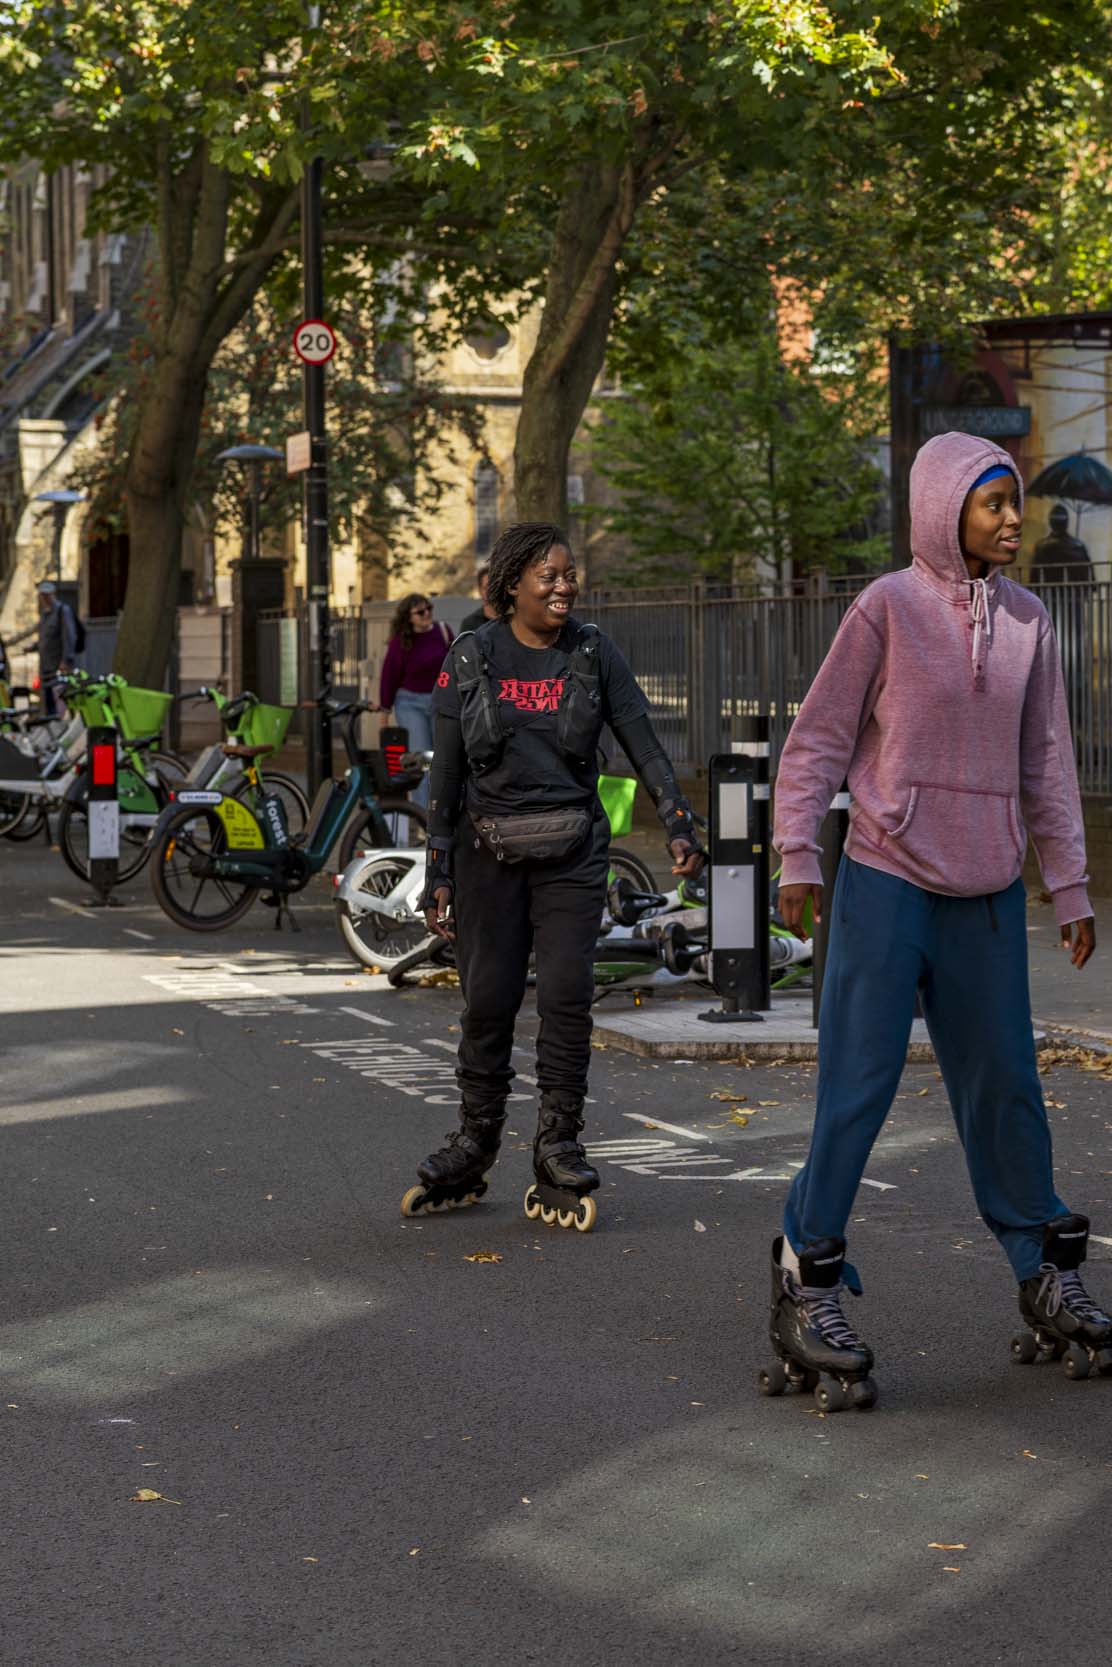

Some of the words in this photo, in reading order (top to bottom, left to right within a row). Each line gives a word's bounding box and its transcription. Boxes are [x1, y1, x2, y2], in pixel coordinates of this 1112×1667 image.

[301, 334, 330, 351] 20
[266, 800, 288, 845] forest
[584, 1138, 791, 1180] ONLY
